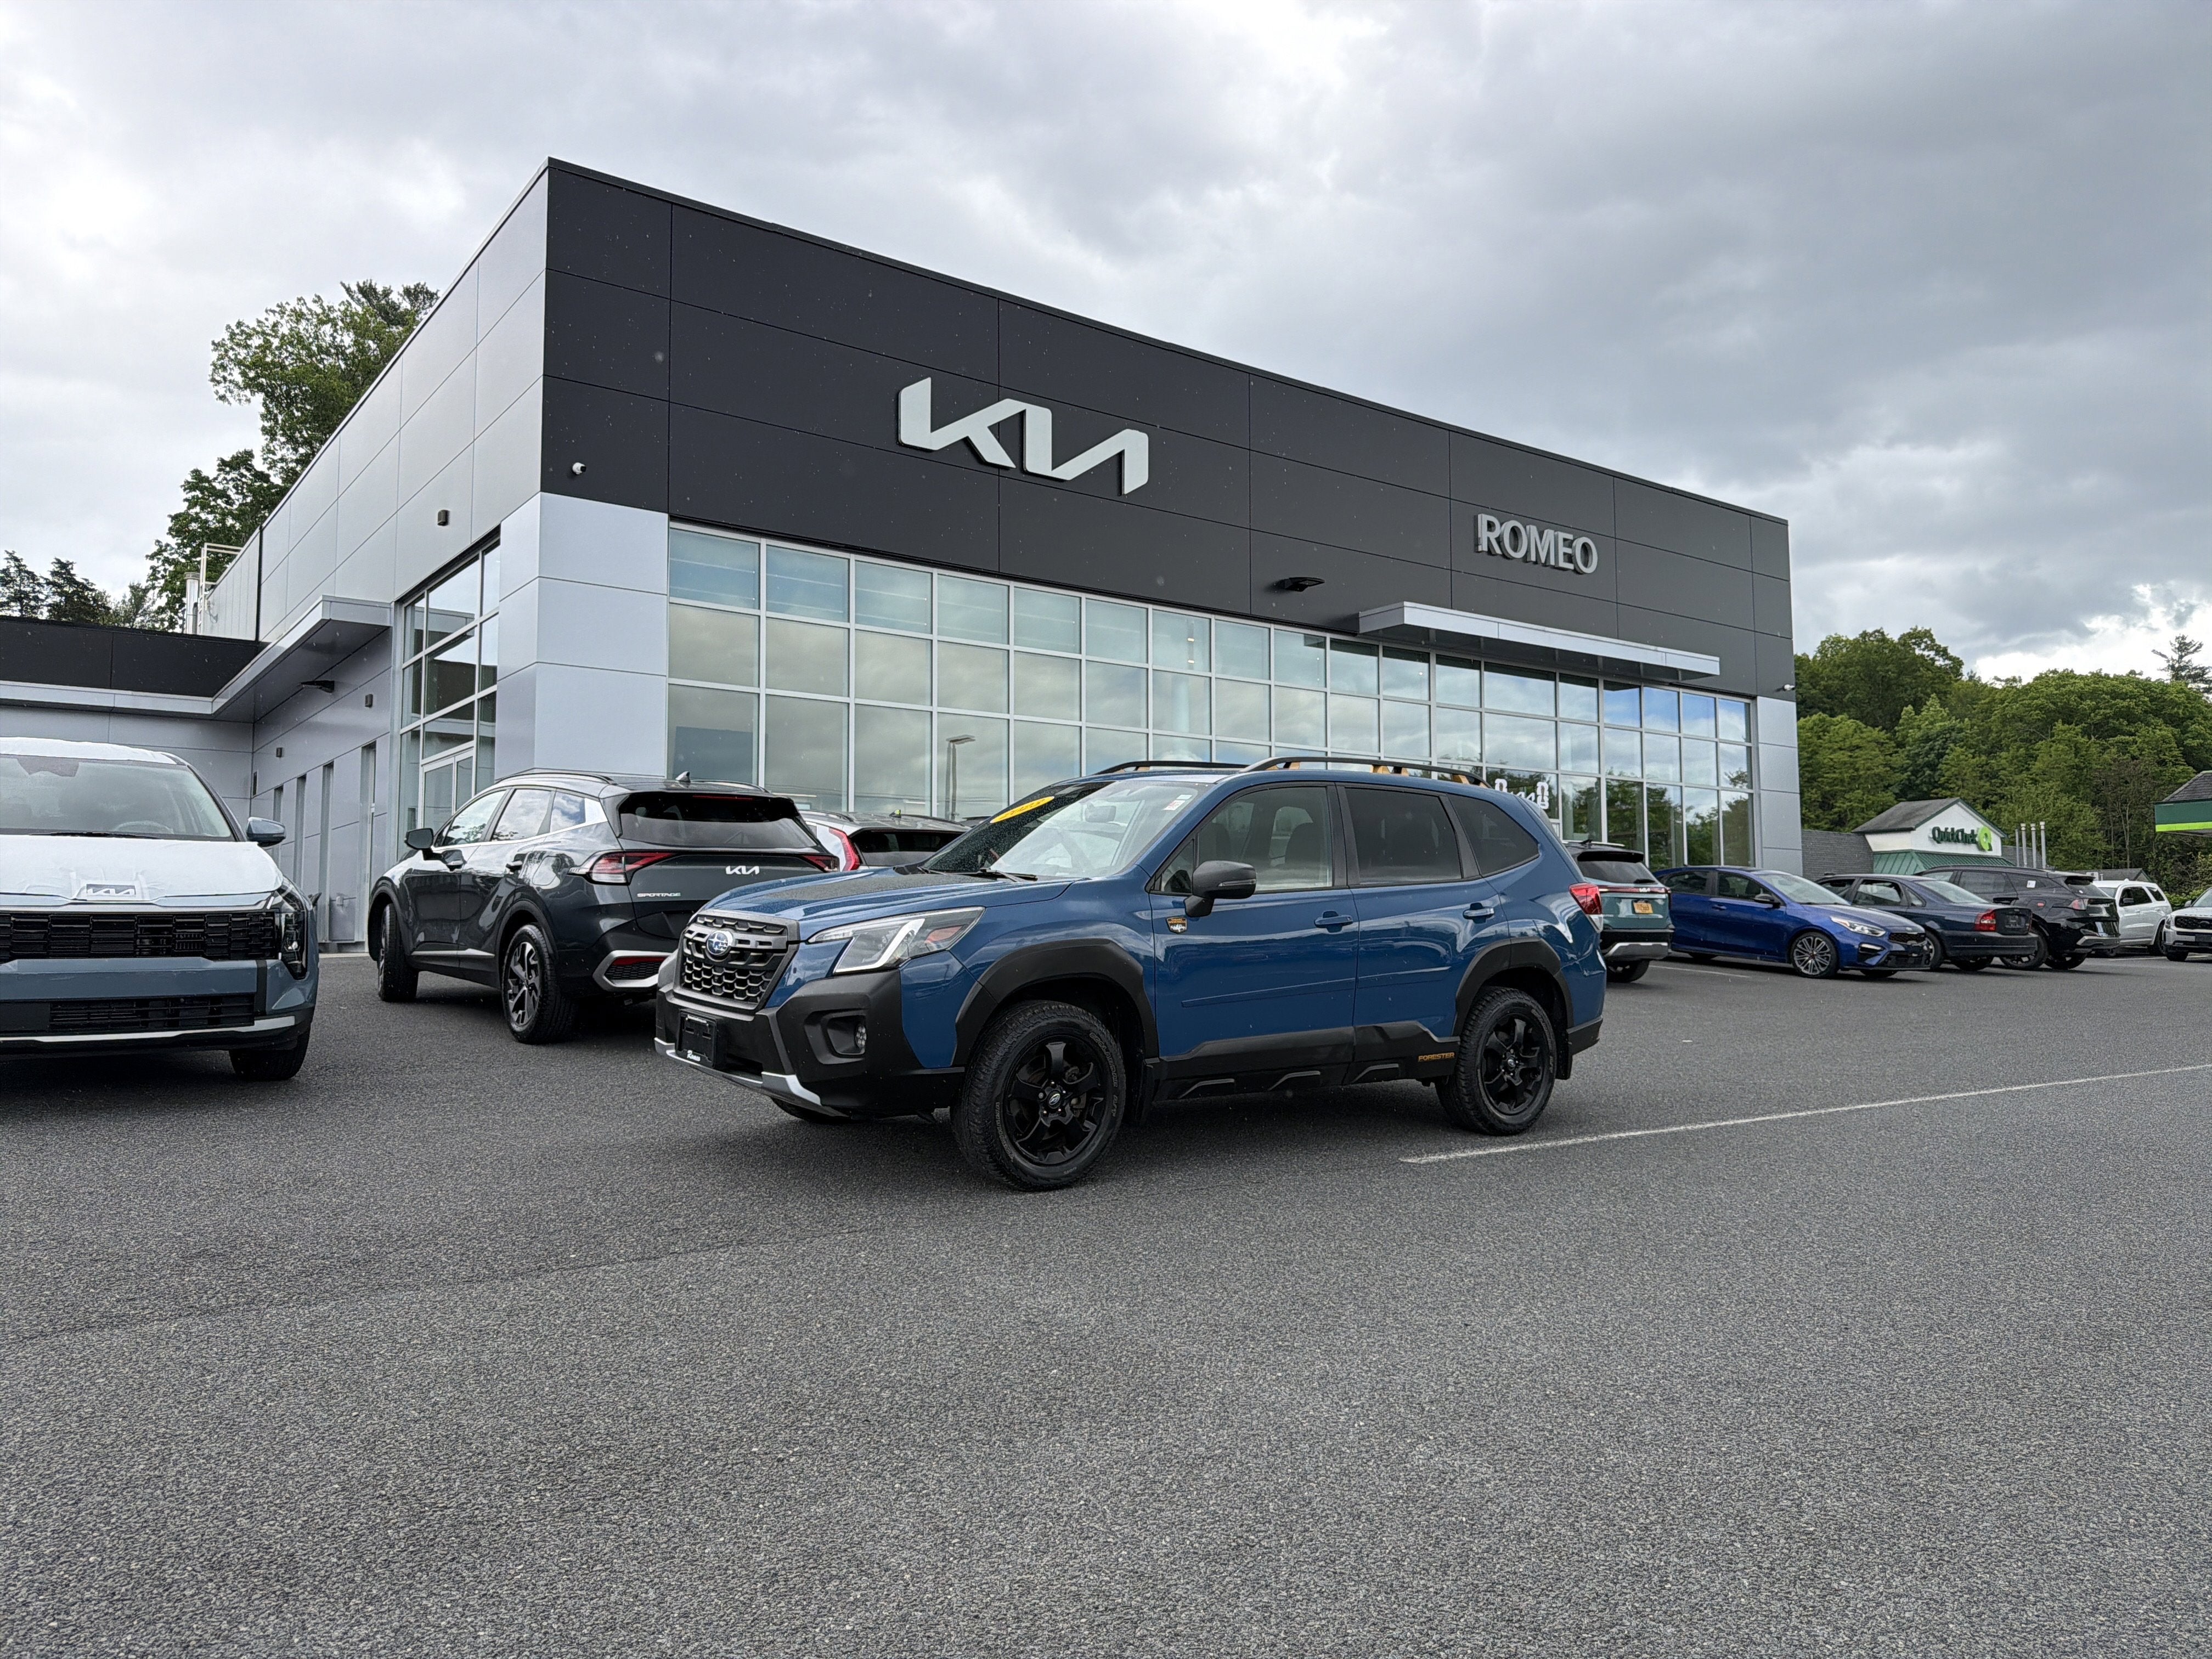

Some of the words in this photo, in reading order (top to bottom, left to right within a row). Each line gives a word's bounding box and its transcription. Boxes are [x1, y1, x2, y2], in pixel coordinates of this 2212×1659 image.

[898, 376, 1149, 495] KIA
[1476, 513, 1598, 574] ROMEO
[725, 865, 760, 875] KIA
[1418, 1052, 1455, 1062] FORESTER
